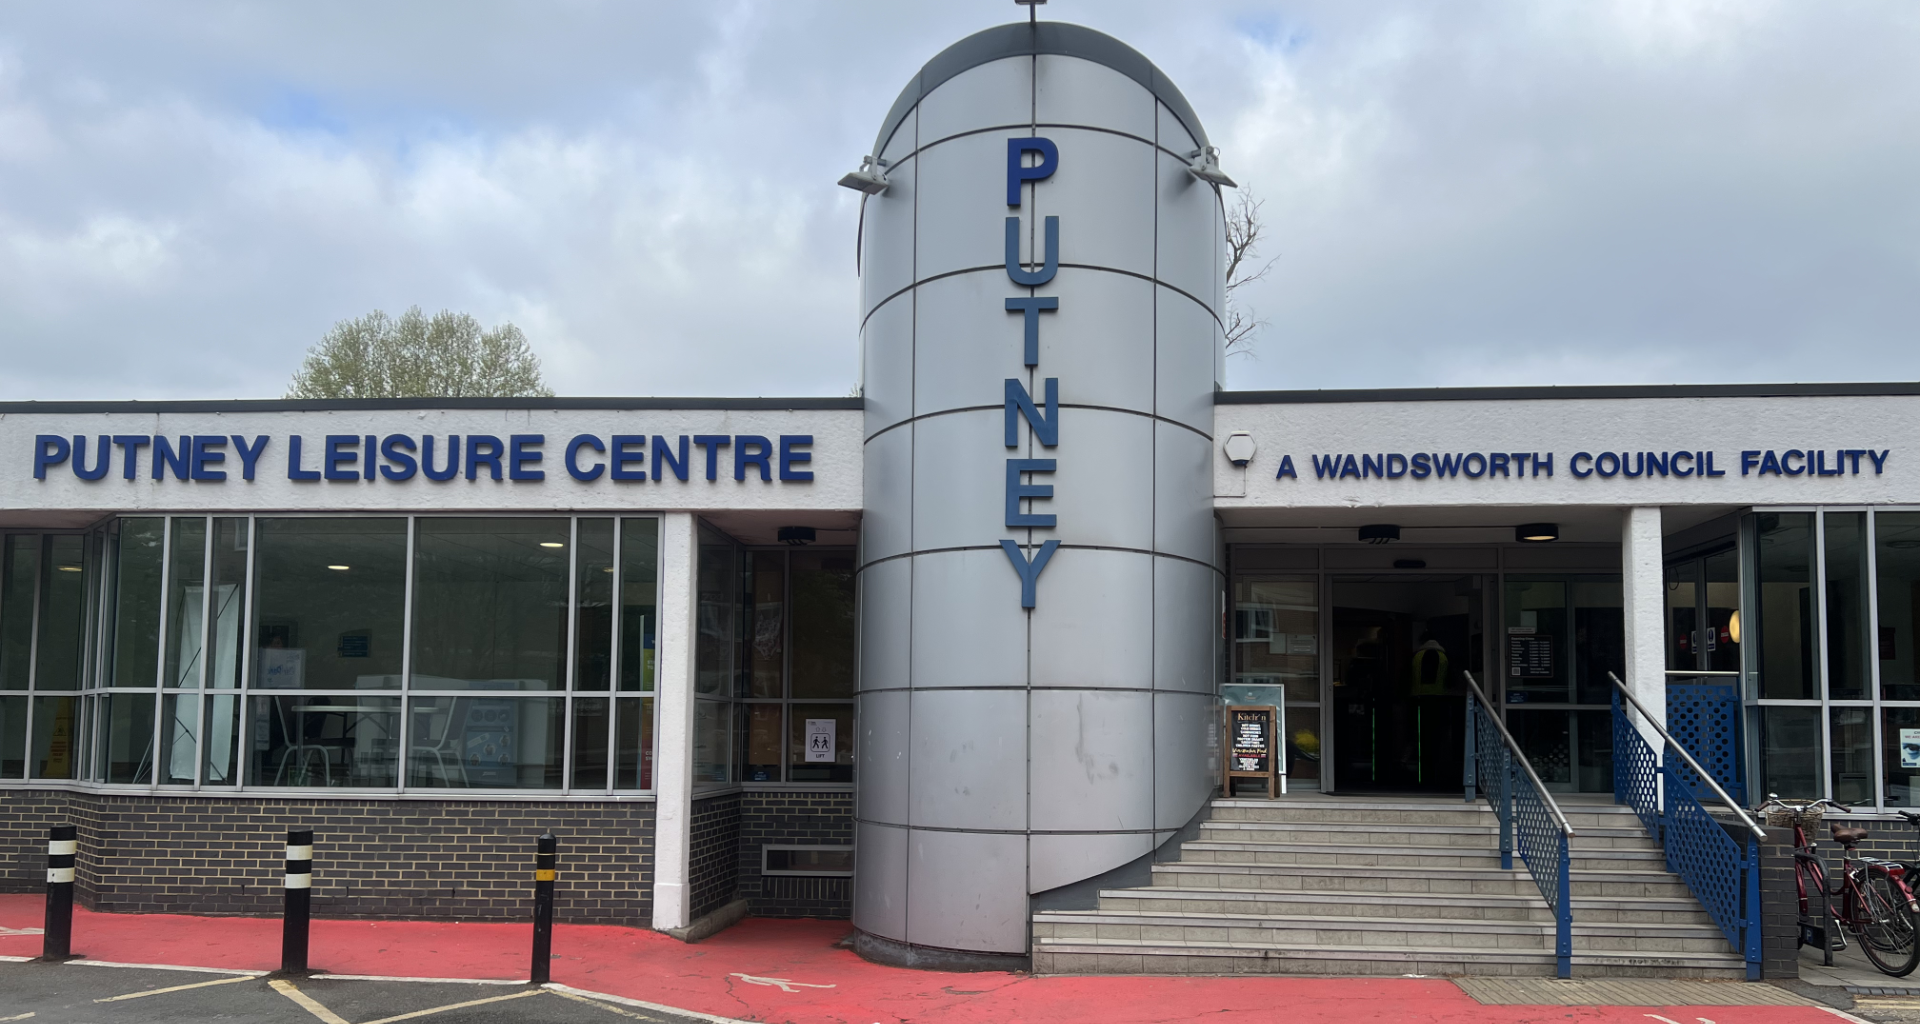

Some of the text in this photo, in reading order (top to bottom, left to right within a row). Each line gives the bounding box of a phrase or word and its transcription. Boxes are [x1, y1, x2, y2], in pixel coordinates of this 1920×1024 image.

[999, 136, 1062, 609] PUTNEY
[33, 433, 815, 482] PUTNEY LEISURE CENTRE
[1276, 448, 1890, 480] A WANDSWORTH COUNCIL FACILITY
[1806, 929, 1812, 941] P
